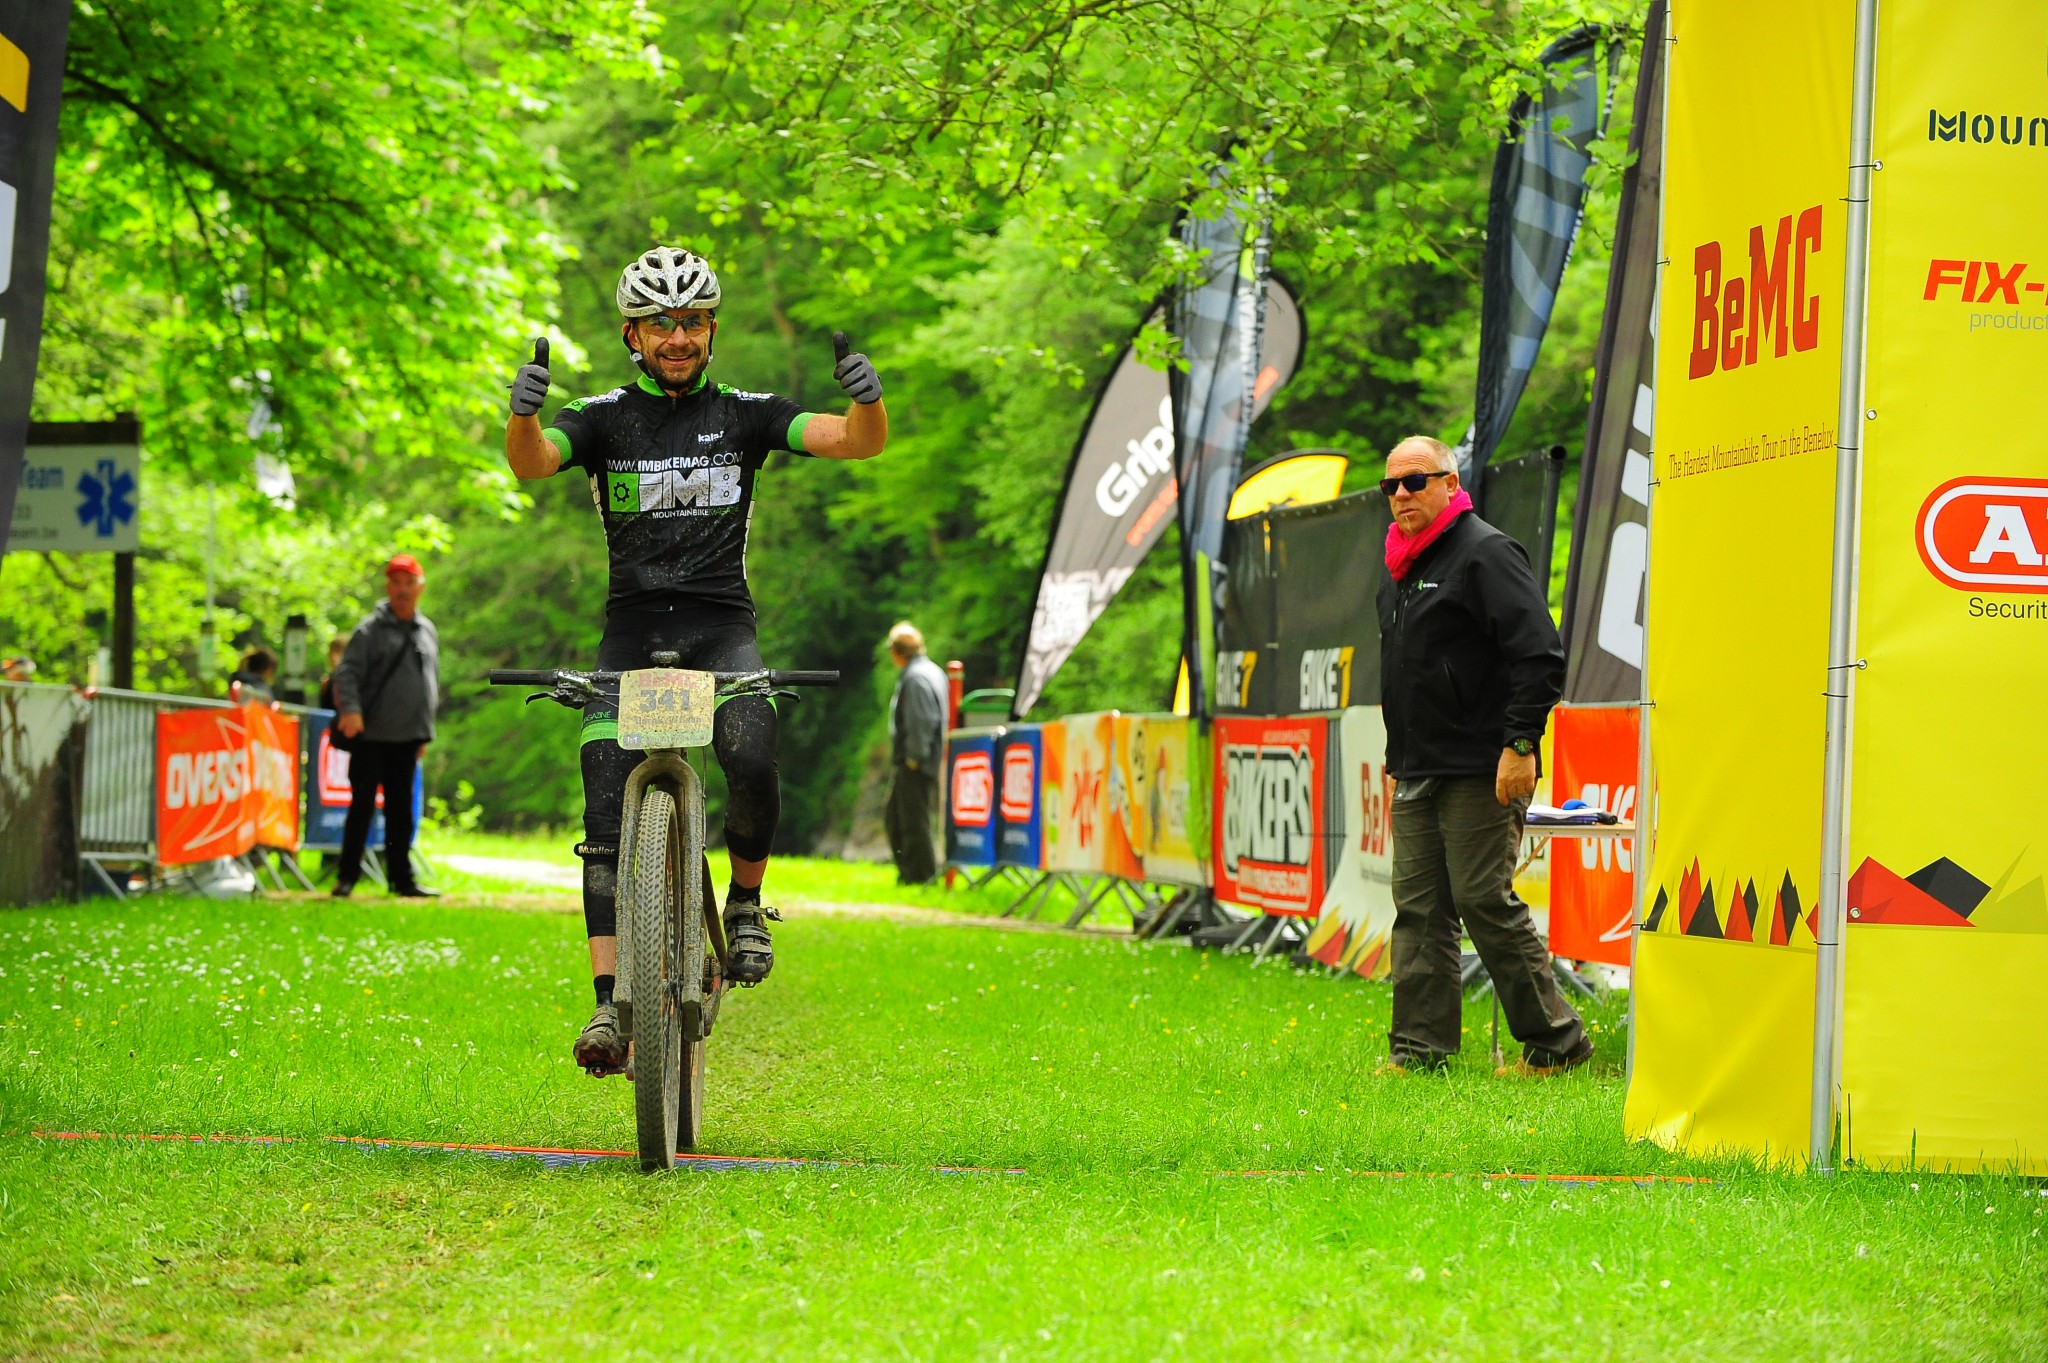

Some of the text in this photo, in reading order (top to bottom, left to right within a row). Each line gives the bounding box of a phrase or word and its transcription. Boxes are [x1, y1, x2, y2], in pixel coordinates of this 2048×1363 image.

[1689, 205, 1822, 380] BeMC
[1923, 259, 2048, 305] FIX-
[606, 451, 743, 472] WWW.IMBIKEMAG.COM
[1669, 422, 1834, 479] The Hardest Mountainbike Tour in the Benelux
[1969, 504, 2048, 566] A
[640, 689, 692, 711] 341
[578, 845, 616, 855] Mueller
